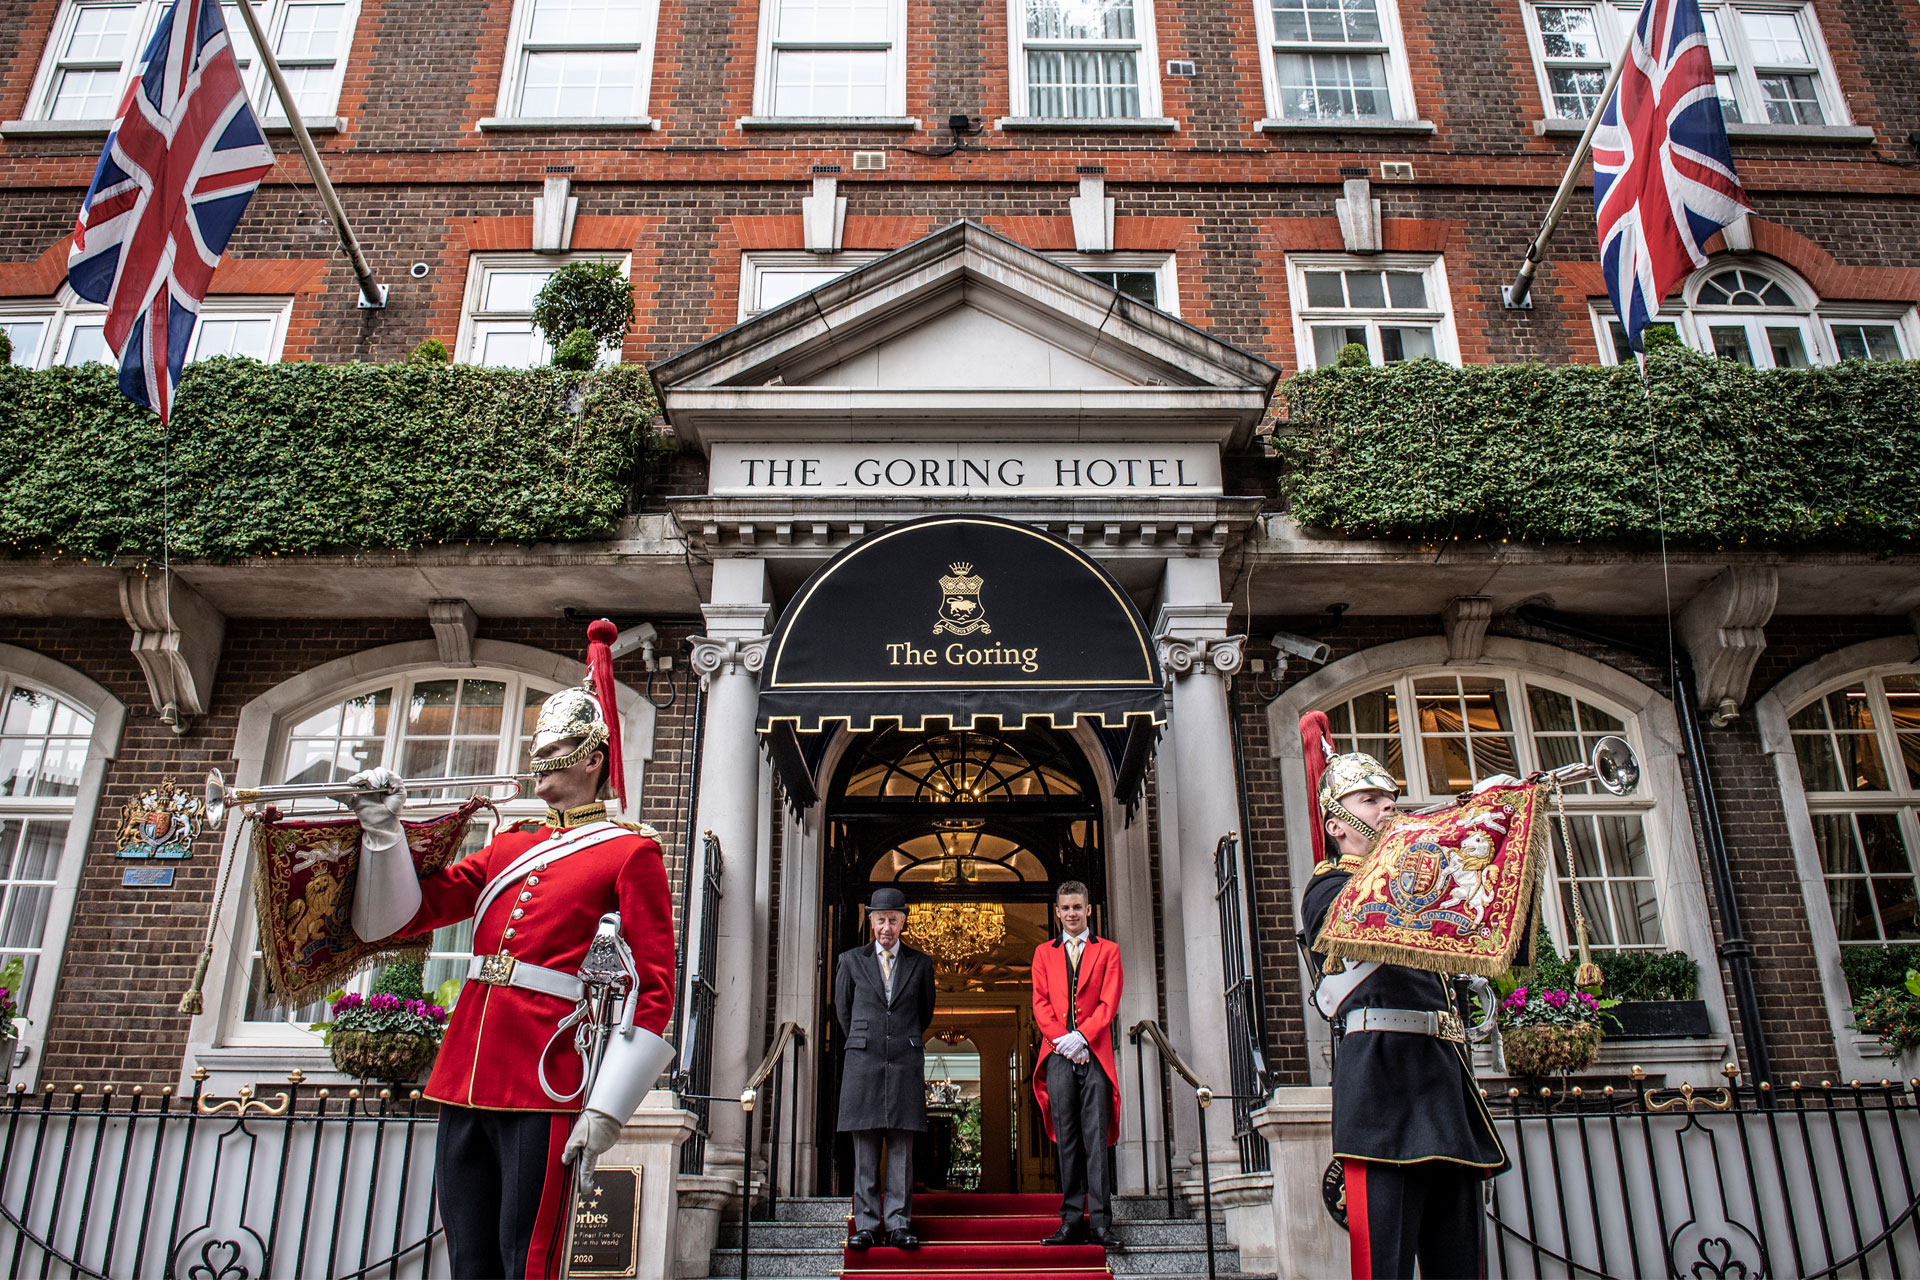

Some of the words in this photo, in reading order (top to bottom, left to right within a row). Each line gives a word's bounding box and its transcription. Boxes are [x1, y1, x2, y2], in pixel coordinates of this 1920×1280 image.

[741, 459, 822, 486] THE
[854, 458, 1025, 487] GORING
[1055, 459, 1198, 487] HOTEL
[886, 641, 938, 666] The
[945, 641, 1039, 673] Goring
[576, 1211, 608, 1224] orbes
[574, 1254, 594, 1263] 2020
